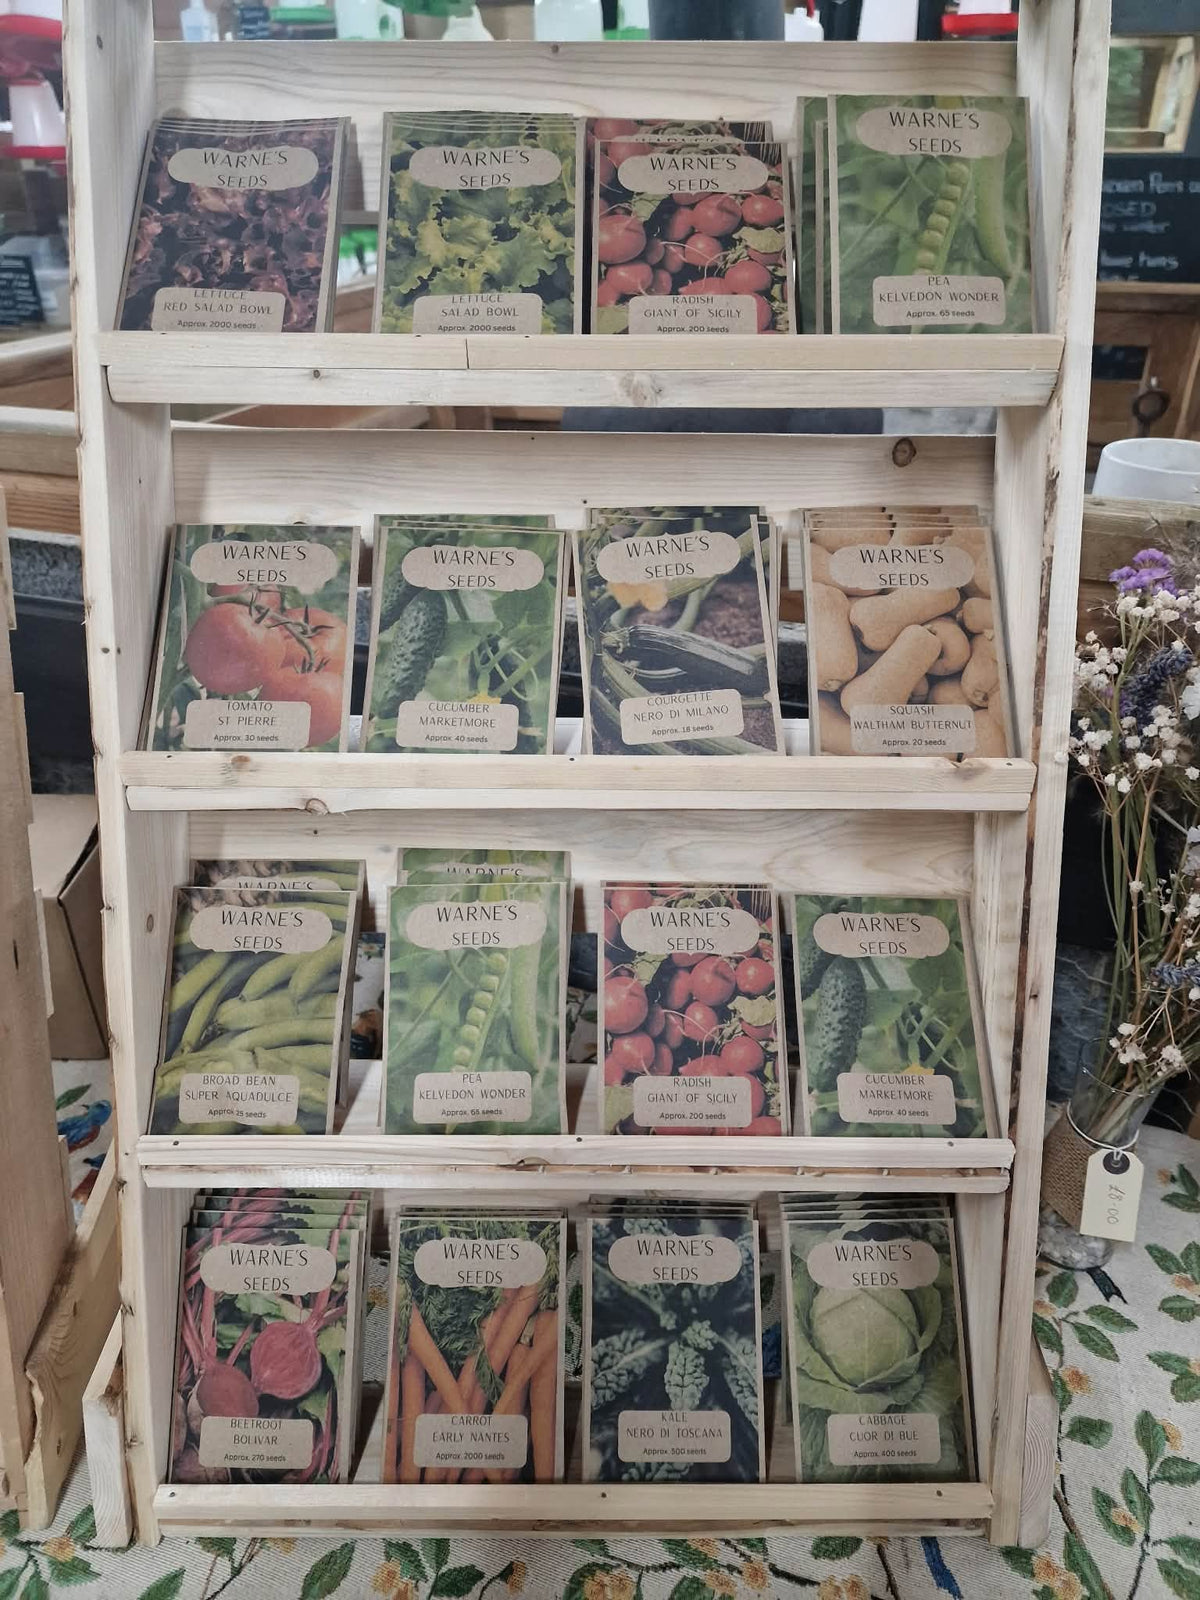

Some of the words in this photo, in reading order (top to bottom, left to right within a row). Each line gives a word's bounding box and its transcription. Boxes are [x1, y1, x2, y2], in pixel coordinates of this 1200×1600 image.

[890, 112, 980, 130] WARNE'S
[909, 138, 962, 153] SEEDS
[203, 151, 288, 168] WARNE'S
[443, 150, 530, 166] WARNE'S
[651, 157, 737, 171] WARNE'S
[217, 175, 268, 188] SEEDS
[460, 173, 511, 188] SEEDS
[668, 179, 719, 192] SEEDS
[928, 277, 950, 286] PEA
[194, 289, 246, 299] LETTUCE
[452, 295, 503, 303] LETTUCE
[673, 296, 714, 304] RADISH
[880, 292, 942, 302] KELVEDON
[950, 292, 999, 302] WONDER
[164, 302, 187, 311] RED
[194, 303, 233, 313] SALAD
[240, 305, 272, 315] BOWL
[442, 307, 480, 317] SALAD
[487, 307, 519, 316] BOWL
[644, 309, 678, 318] GIANT
[686, 308, 700, 317] OF
[709, 308, 742, 318] SICILY
[626, 535, 710, 558] WARNE'S
[223, 546, 307, 561] WARNE'S
[434, 550, 515, 567] WARNE'S
[860, 548, 944, 564] WARNE'S
[237, 570, 287, 582] SEEDS
[645, 563, 695, 579] SEEDS
[448, 575, 496, 588] SEEDS
[879, 573, 929, 586] SEEDS
[647, 692, 713, 707] COURGETTE
[228, 702, 272, 711] TOMATO
[428, 703, 489, 713] CUCUMBER
[890, 705, 934, 716] SQUASH
[634, 711, 663, 722] NERO
[669, 710, 680, 719] DI
[686, 705, 729, 718] MILANO
[218, 717, 231, 726] ST
[238, 717, 277, 726] PIERRE
[419, 717, 496, 728] MARKETMORE
[854, 720, 905, 730] WALTHAM
[911, 720, 971, 730] BUTTERNUT
[222, 910, 304, 927] WARNE'S
[437, 904, 518, 923] WARNE'S
[650, 911, 731, 928] WARNE'S
[841, 917, 921, 933] WARNE'S
[234, 936, 283, 949] SEEDS
[451, 931, 501, 946] SEEDS
[667, 937, 715, 951] SEEDS
[859, 942, 907, 955] SEEDS
[203, 1075, 240, 1086] BROAD
[246, 1076, 276, 1086] BEAN
[463, 1073, 482, 1083] PEA
[673, 1077, 711, 1087] RADISH
[865, 1075, 925, 1085] CUCUMBER
[185, 1091, 219, 1101] SUPER
[226, 1091, 293, 1103] AQUADULCE
[419, 1090, 474, 1100] KELVEDON
[481, 1089, 526, 1099] WONDER
[647, 1093, 678, 1103] GIANT
[686, 1093, 700, 1103] OF
[706, 1093, 737, 1104] SICILY
[859, 1090, 934, 1101] MARKETMORE
[236, 1109, 244, 1117] 25
[245, 1111, 267, 1119] seeds
[705, 1112, 726, 1120] seeds
[908, 1109, 929, 1117] seeds
[444, 1243, 521, 1260] WARNE'S
[637, 1239, 714, 1256] WARNE'S
[835, 1245, 913, 1262] WARNE'S
[230, 1249, 309, 1267] WARNE'S
[458, 1270, 503, 1284] SEEDS
[653, 1267, 699, 1281] SEEDS
[852, 1272, 899, 1286] SEEDS
[243, 1277, 290, 1291] SEEDS
[451, 1416, 492, 1426] CARROT
[661, 1412, 688, 1422] KALE
[859, 1415, 907, 1425] CABBAGE
[231, 1419, 282, 1430] BEETROOT
[433, 1432, 464, 1443] EARLY
[470, 1432, 510, 1442] NANTES
[627, 1428, 654, 1438] NERO
[661, 1428, 670, 1438] DI
[677, 1428, 722, 1438] TOSCANA
[850, 1431, 878, 1441] CUOR
[885, 1431, 894, 1440] DI
[900, 1431, 919, 1440] BUE
[234, 1434, 278, 1445] BOLIVAR
[464, 1452, 483, 1460] 2000
[484, 1452, 505, 1460] seeds
